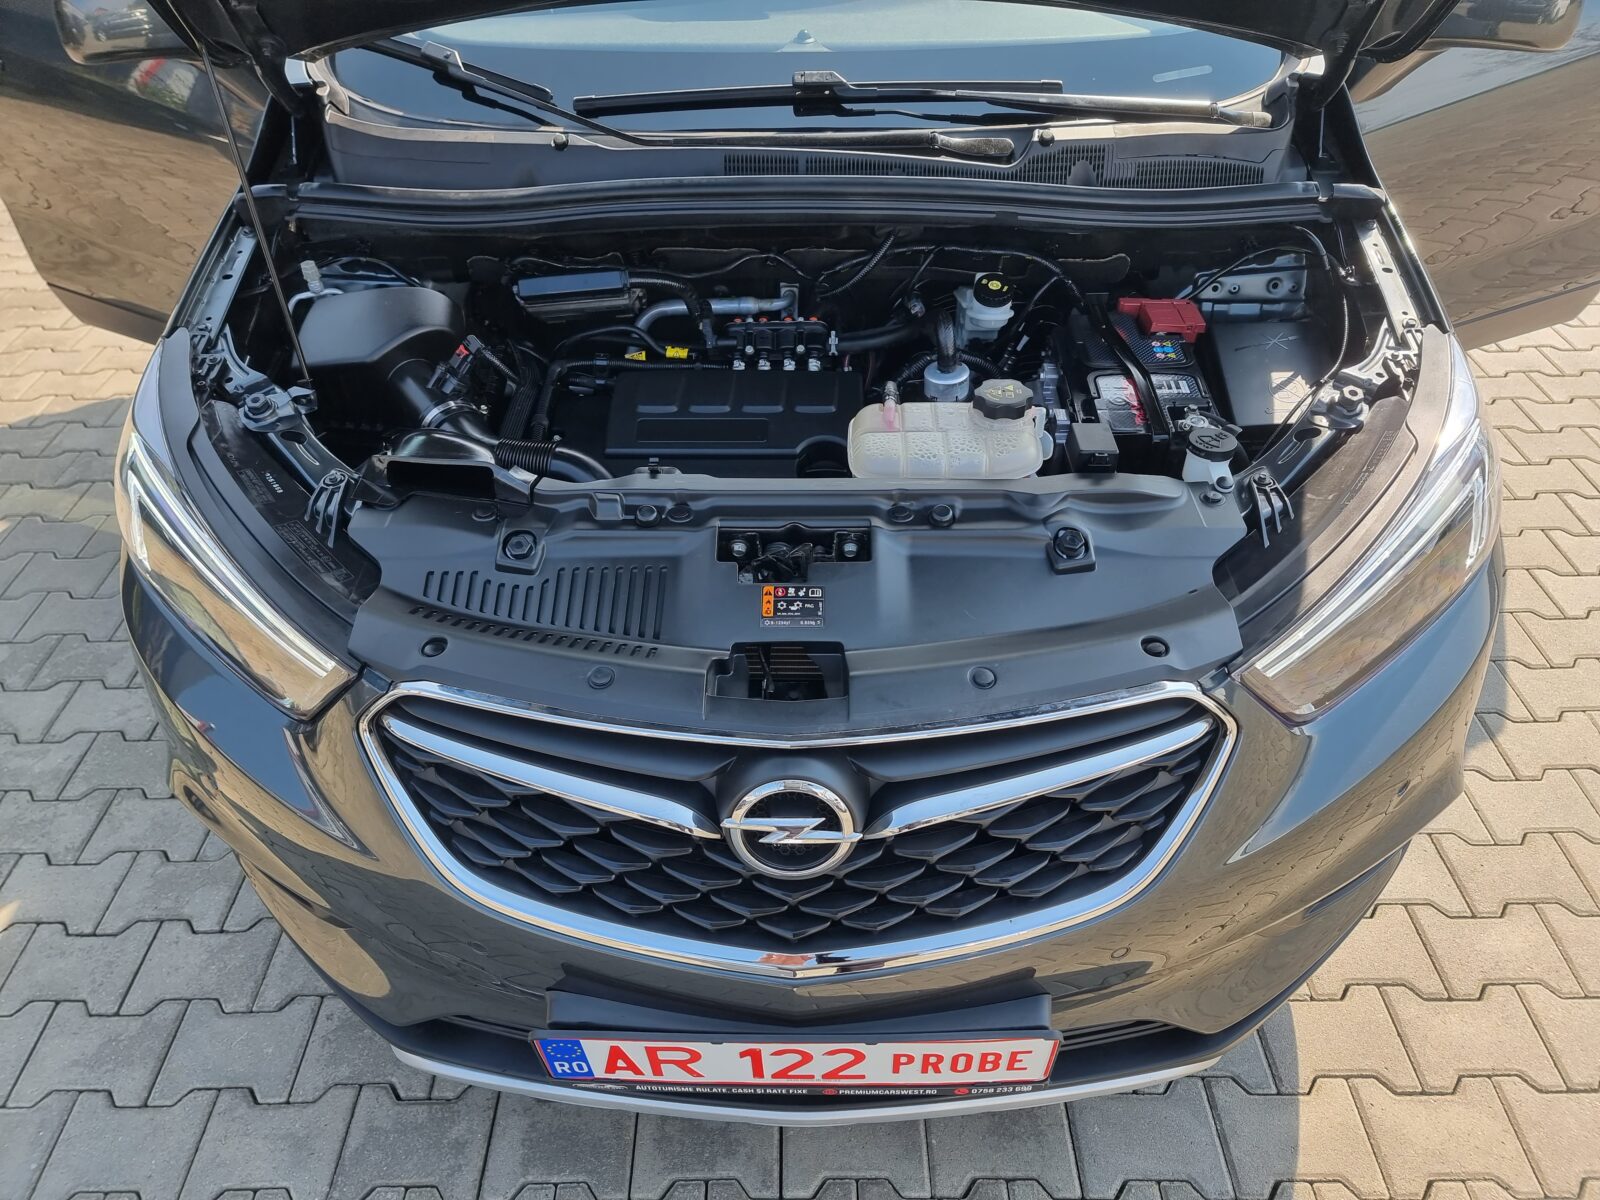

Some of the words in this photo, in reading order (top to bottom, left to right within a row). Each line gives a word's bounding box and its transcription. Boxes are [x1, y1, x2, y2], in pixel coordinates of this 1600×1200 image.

[553, 1061, 588, 1073] RO
[604, 1045, 704, 1077] AR
[738, 1048, 866, 1079] 122
[892, 1051, 1032, 1074] PROBE
[635, 1085, 694, 1093] AUTOTURISME
